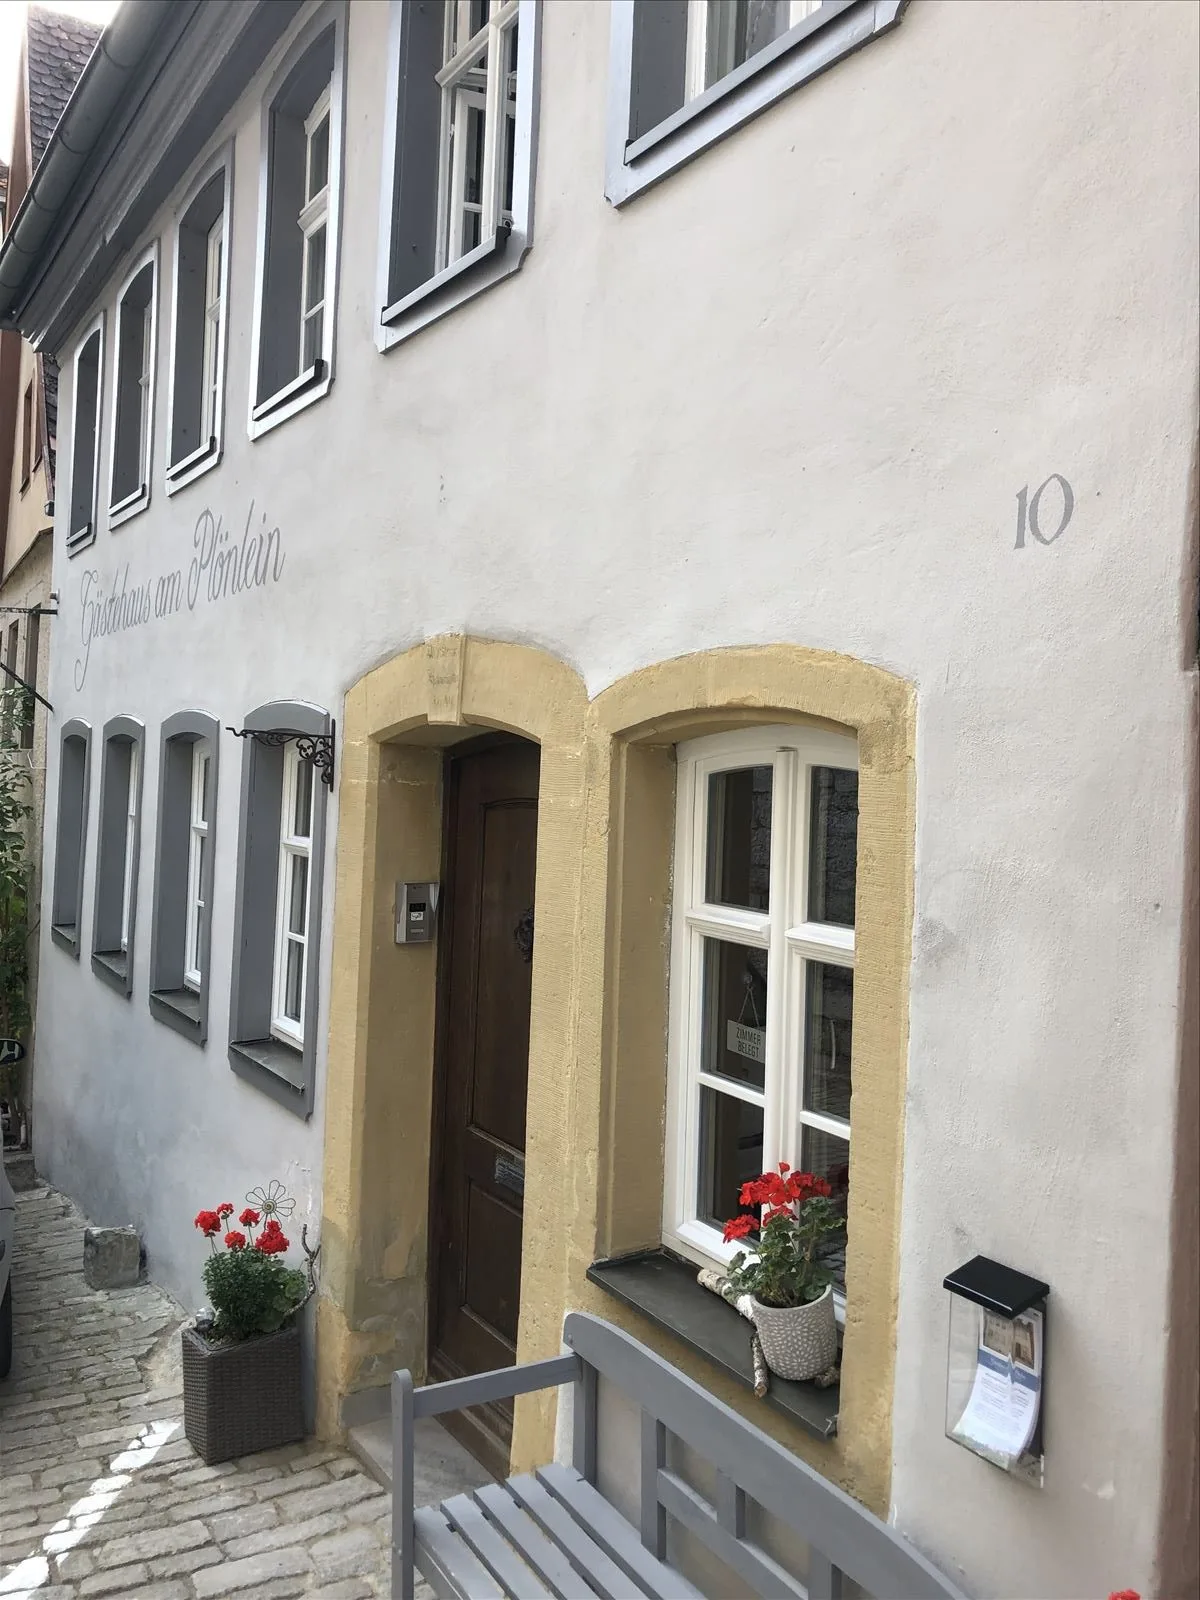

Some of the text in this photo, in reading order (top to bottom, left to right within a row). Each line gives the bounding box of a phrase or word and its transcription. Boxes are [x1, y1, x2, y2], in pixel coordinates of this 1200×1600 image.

[1014, 473, 1074, 549] 10
[75, 499, 286, 692] Gästehaus am Plönlein
[736, 1026, 761, 1046] ZIMMER
[738, 1040, 760, 1058] BELEGT
